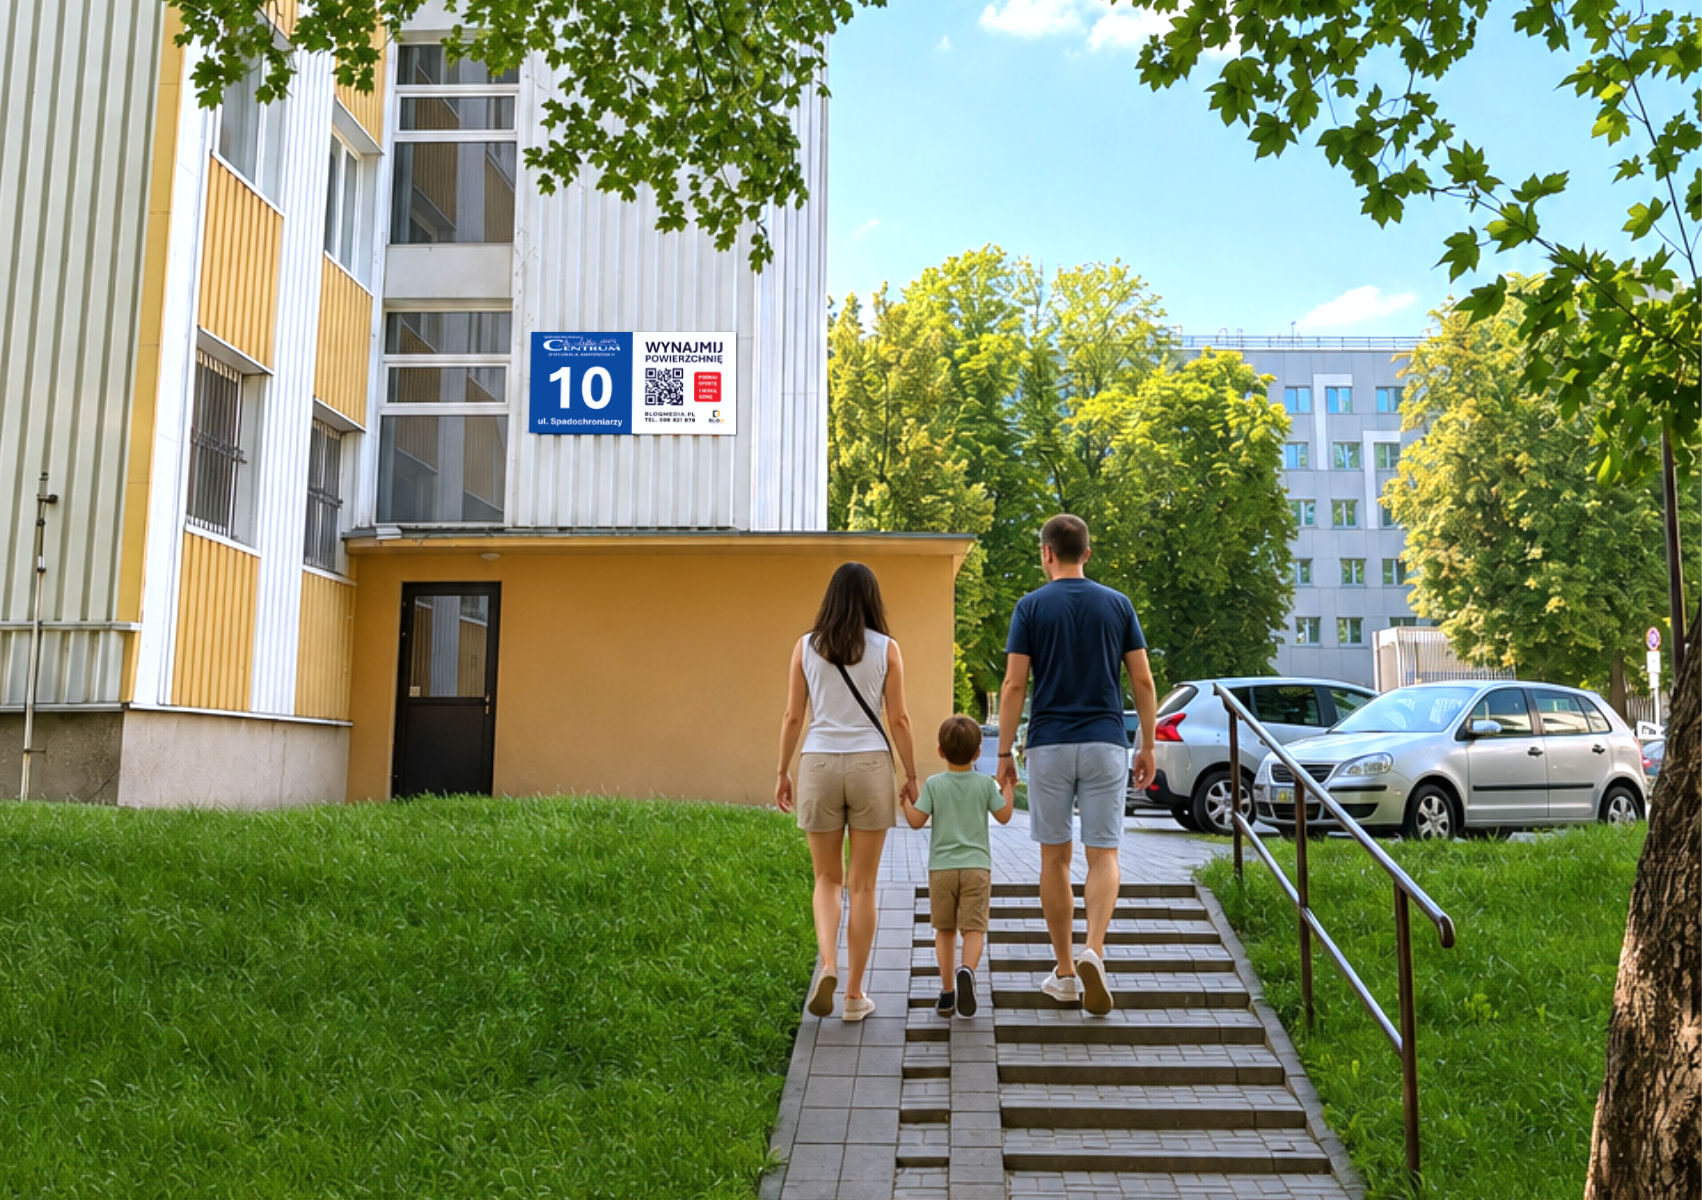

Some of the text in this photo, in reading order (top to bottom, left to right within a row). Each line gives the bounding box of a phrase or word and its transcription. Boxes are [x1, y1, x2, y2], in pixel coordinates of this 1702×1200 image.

[543, 339, 621, 352] CENTRUM
[645, 341, 723, 353] WYNAJMIJ
[645, 354, 723, 364] POWIERZCHNIĘ
[549, 366, 613, 410] 10
[537, 417, 623, 428] ul. Spadochroniarzy
